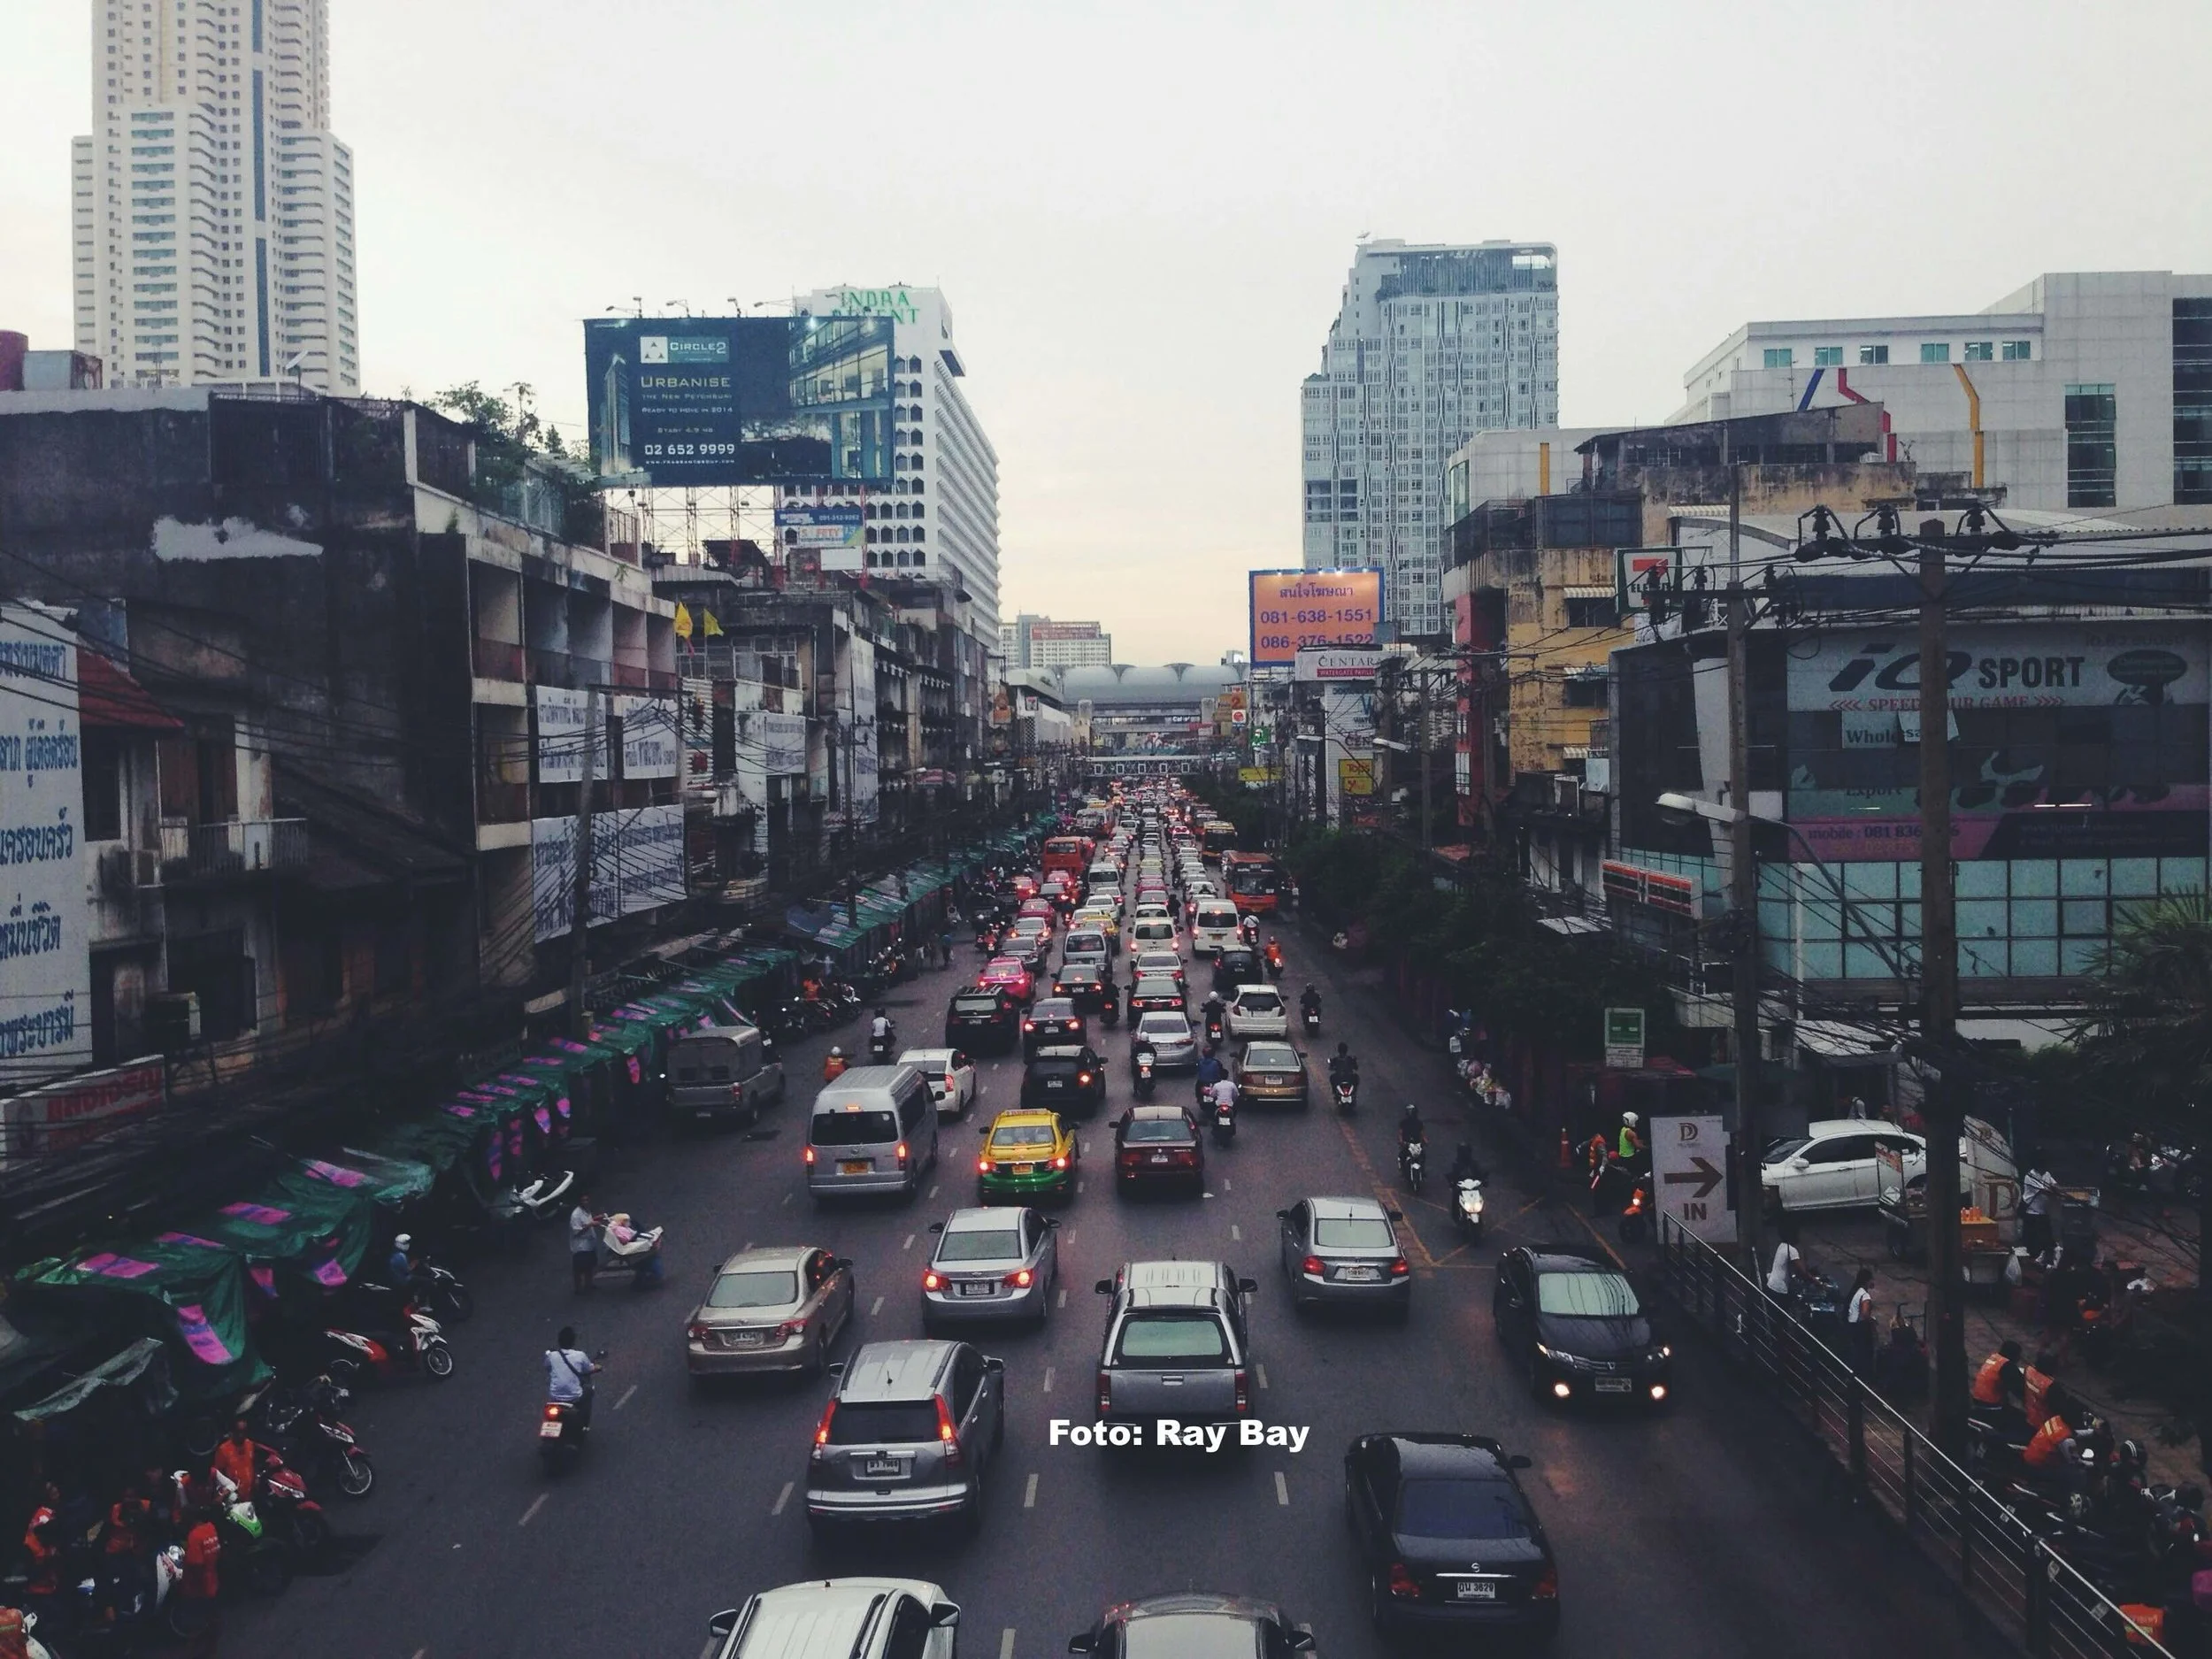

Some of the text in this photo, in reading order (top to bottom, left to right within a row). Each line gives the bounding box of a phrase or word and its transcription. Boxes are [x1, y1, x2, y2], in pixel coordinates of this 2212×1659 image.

[841, 290, 910, 307] INDRA
[644, 443, 735, 455] 02 652 9999
[1260, 609, 1371, 624] 081-638-1551
[1260, 634, 1374, 649] 086-376-1522
[1978, 656, 2085, 689] SPORT
[1979, 695, 2029, 707] GAME
[1809, 826, 1854, 840] mobile
[1864, 826, 1891, 838] 081
[1895, 825, 1922, 838] 836
[1683, 1202, 1707, 1220] IN
